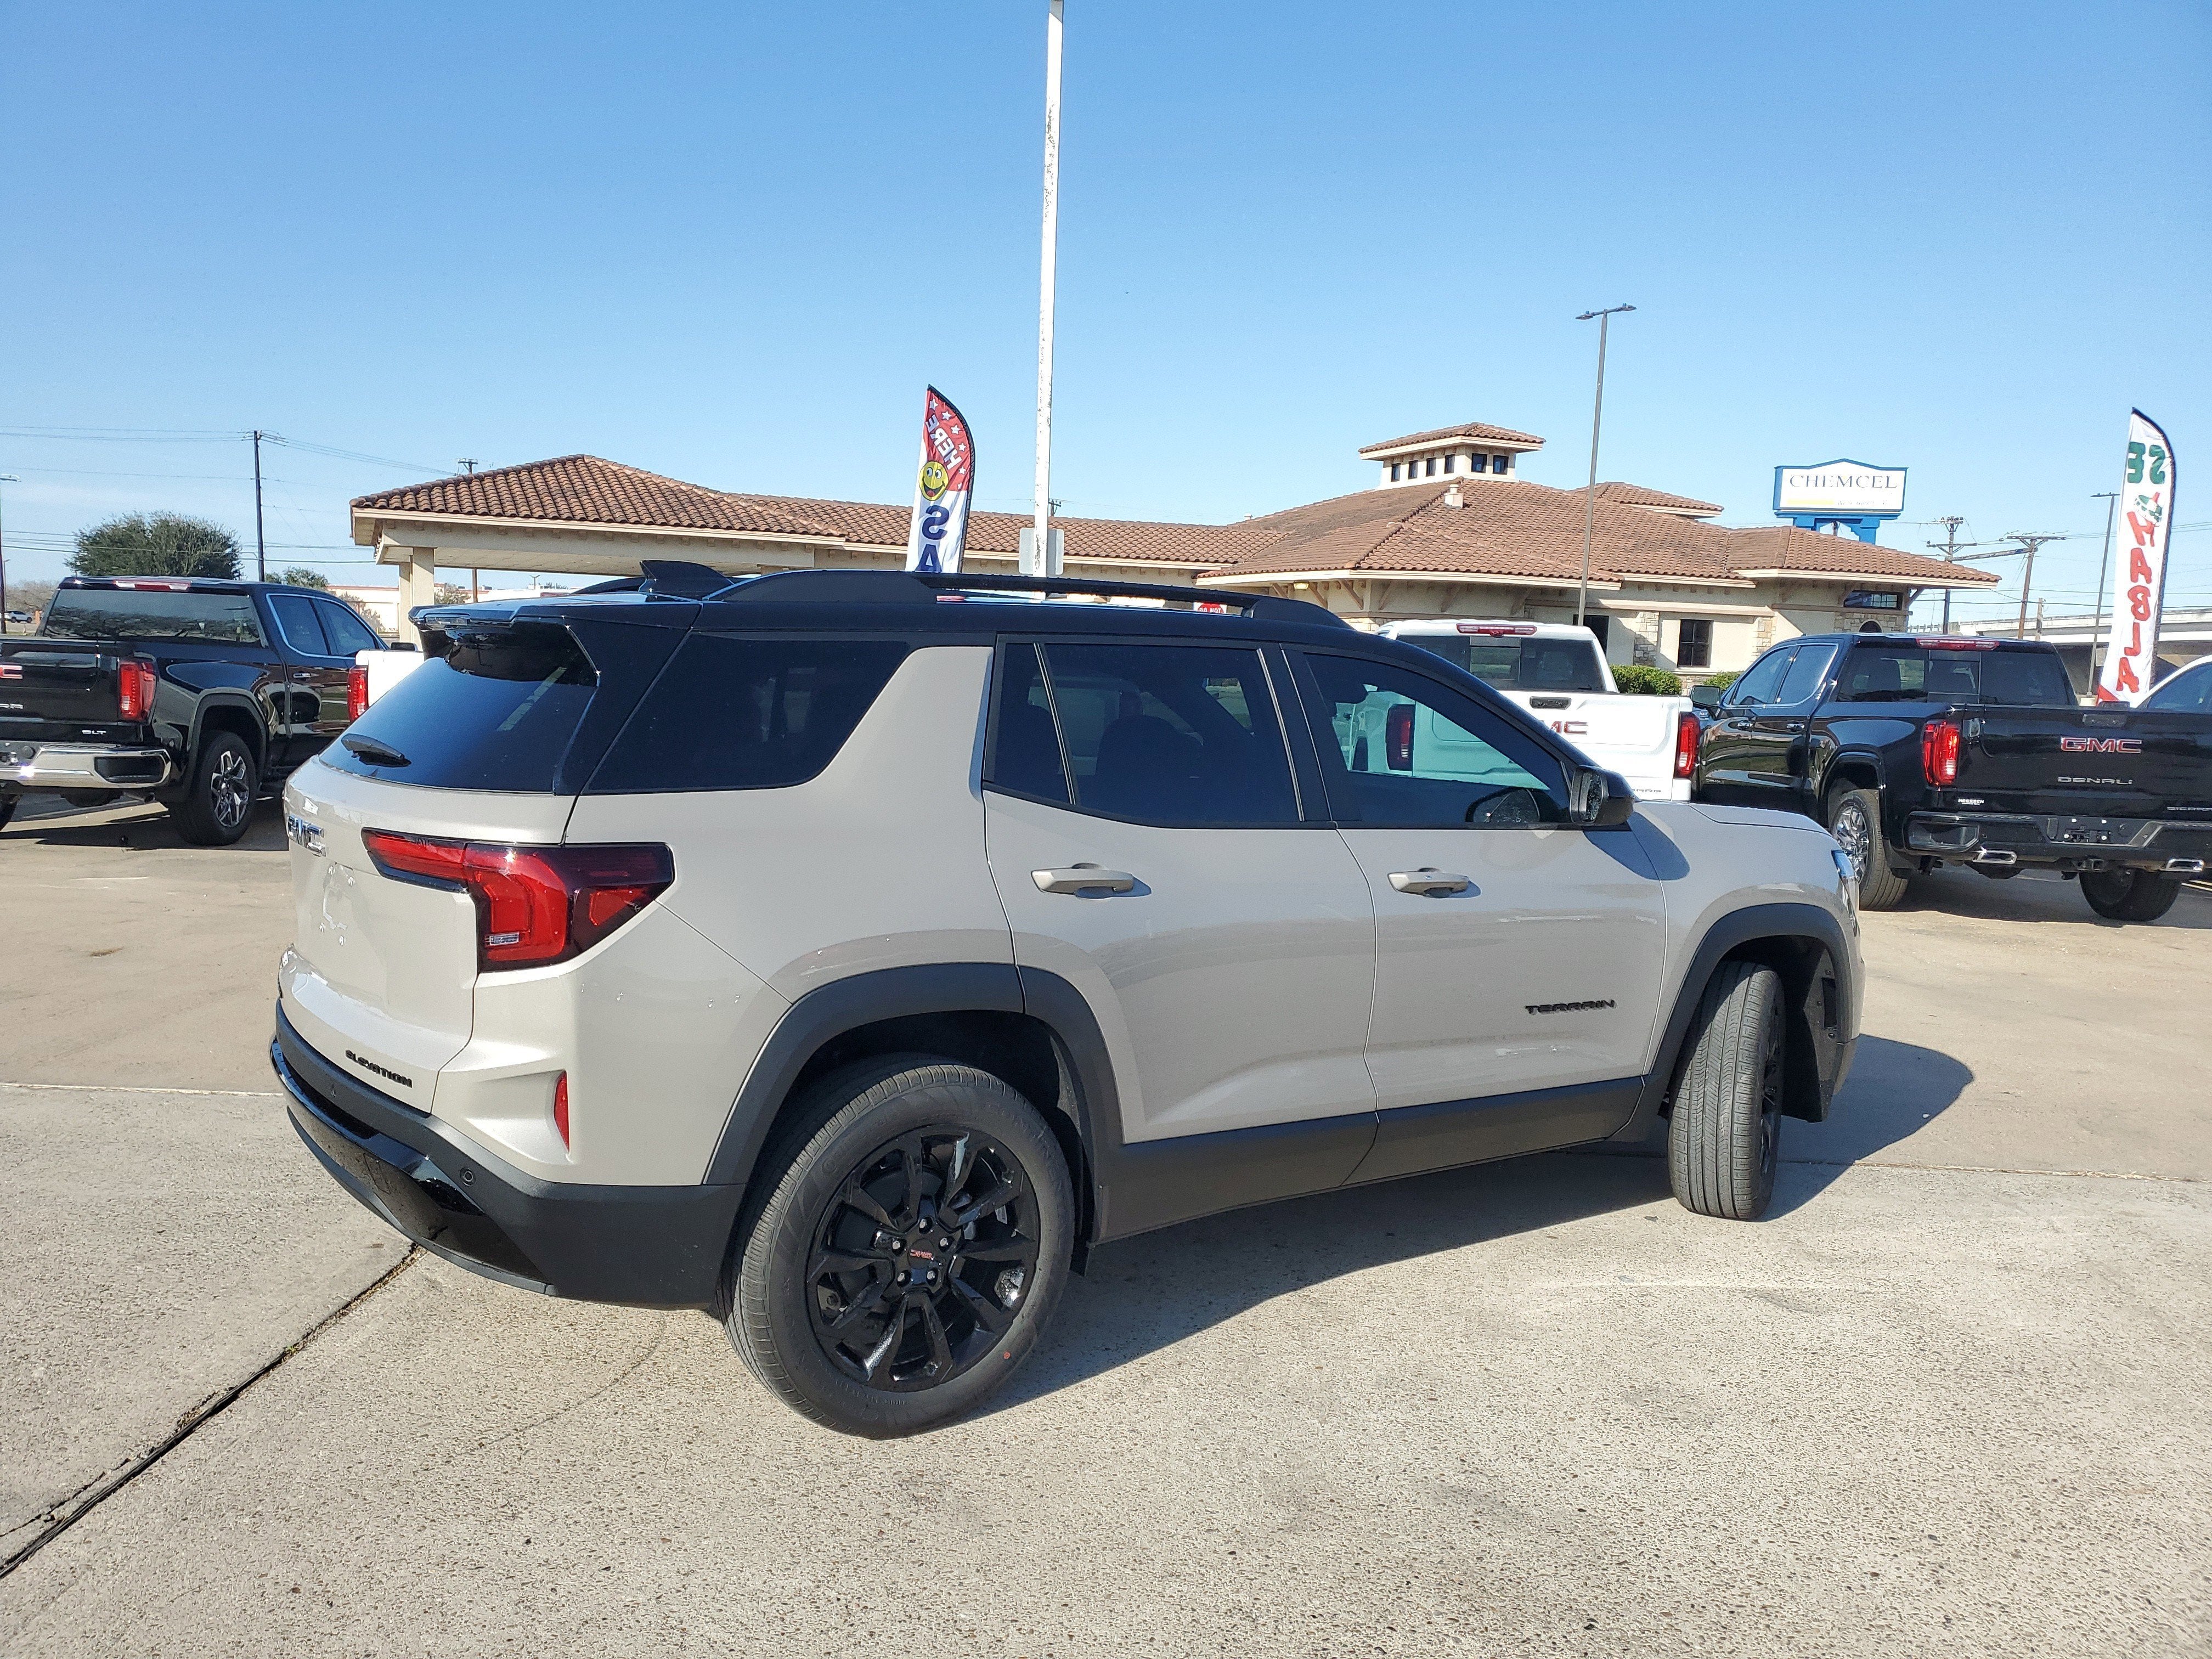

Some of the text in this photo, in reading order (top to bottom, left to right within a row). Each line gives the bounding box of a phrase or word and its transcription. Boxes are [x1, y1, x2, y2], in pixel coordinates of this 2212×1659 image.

[1790, 475, 1897, 488] CHEMCEL
[2061, 736, 2142, 754] GMC
[2058, 776, 2133, 785] DENALI
[1525, 999, 1615, 1014] TERRAIN
[345, 1049, 413, 1088] ELEVATION
